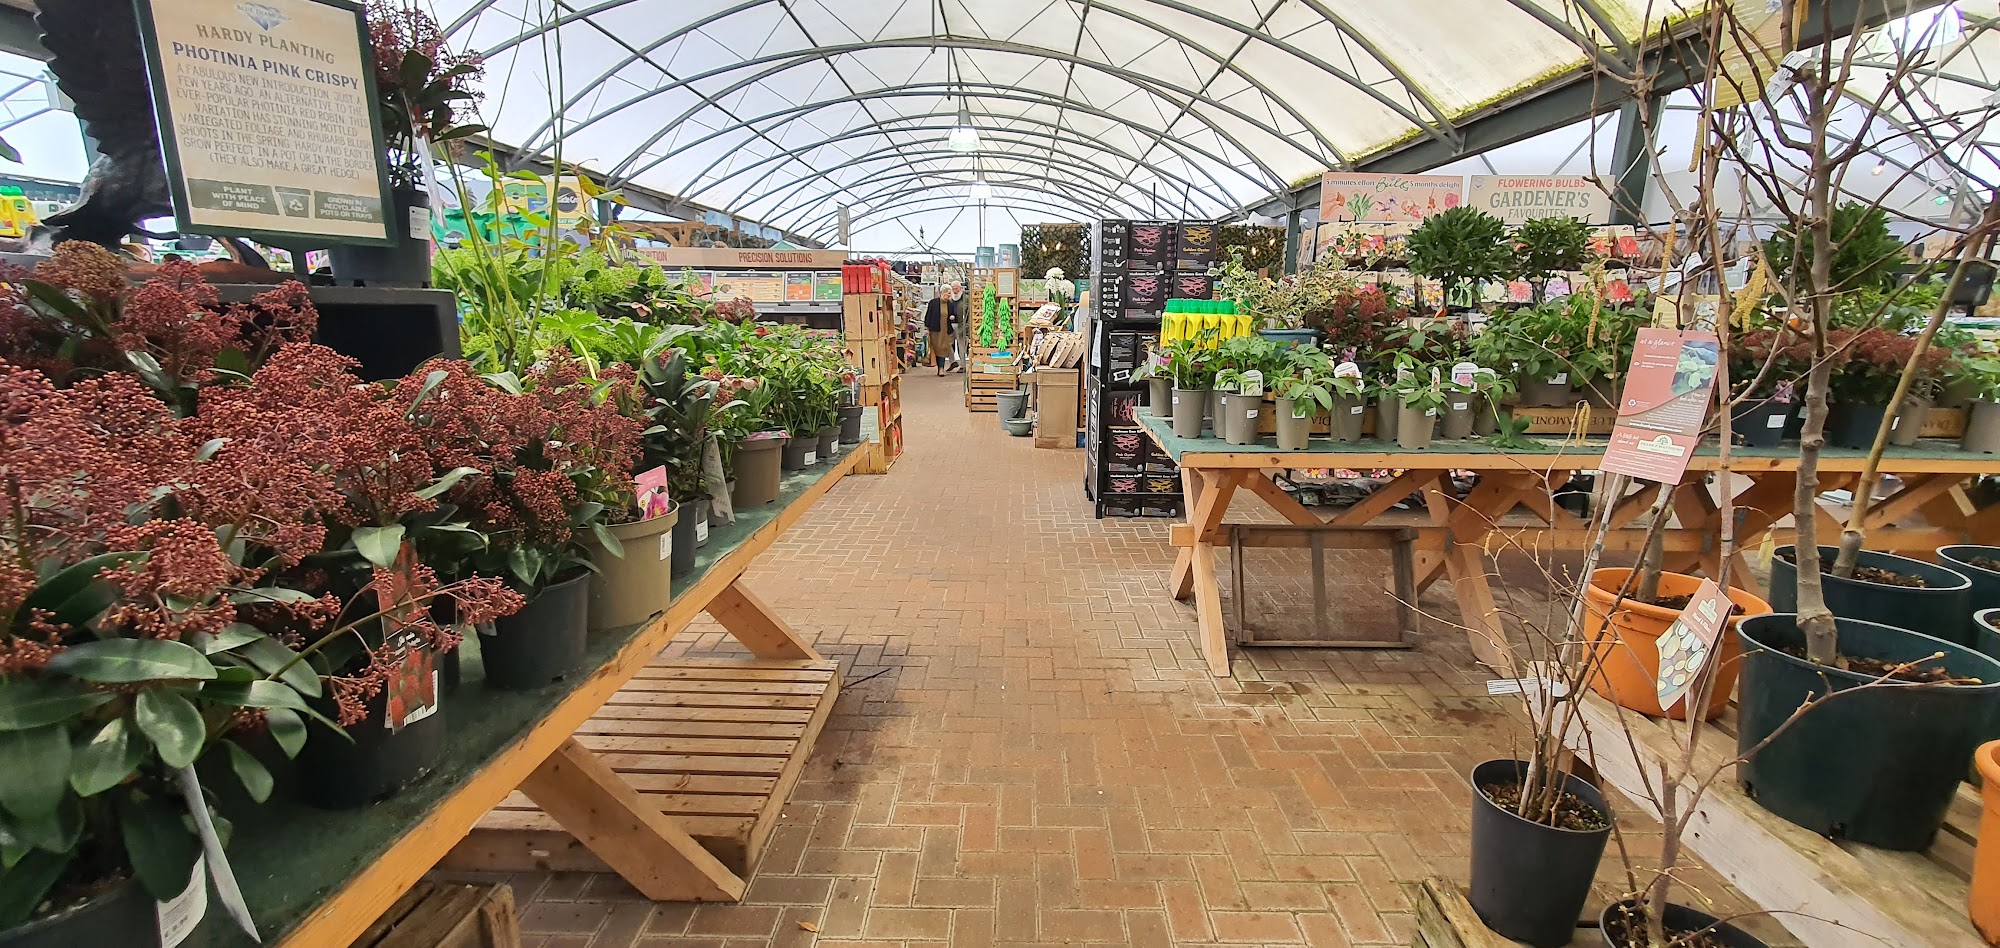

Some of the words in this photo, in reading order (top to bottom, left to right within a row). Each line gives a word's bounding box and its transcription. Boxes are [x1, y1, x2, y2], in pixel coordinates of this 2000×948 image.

[196, 24, 253, 45] HARDY
[258, 33, 335, 65] PLANTING
[172, 41, 258, 71] PHOTINIA
[262, 59, 301, 79] PINK
[305, 68, 359, 90] CRISPY
[177, 63, 185, 74] A
[186, 64, 237, 83] FABULOUS
[239, 74, 259, 87] NEW
[177, 75, 199, 88] FEW
[201, 79, 232, 94] YEARS
[260, 91, 272, 101] AN
[274, 92, 333, 114] ALTERNATIVE
[336, 103, 347, 114] TO
[348, 104, 362, 117] THE
[176, 88, 250, 109] EVER-POPULAR
[251, 99, 298, 117] PHOTINIA
[299, 107, 316, 119] RED
[347, 116, 369, 129] THIS
[194, 101, 251, 121] VARIATION
[252, 112, 272, 124] HAS
[272, 114, 319, 131] STUNNING
[320, 122, 358, 137] MOTTLED
[179, 112, 243, 131] VARIEGATED
[245, 121, 285, 137] FOLIAGE
[287, 128, 305, 140] AND
[307, 130, 346, 147] RHUBARB
[347, 138, 373, 150] BLUSH
[179, 124, 219, 140] SHOOTS
[221, 129, 233, 141] IN
[235, 132, 255, 145] THE
[295, 140, 322, 153] HARDY
[324, 145, 342, 157] AND
[344, 147, 363, 159] EASY
[365, 151, 374, 161] TO
[183, 136, 212, 150] GROW
[213, 140, 254, 156] PERFECT
[258, 148, 270, 158] IN
[272, 149, 279, 158] A
[280, 150, 297, 161] POT
[299, 152, 312, 163] OR
[313, 153, 325, 165] IN
[326, 155, 342, 167] THE
[344, 159, 374, 171] BORDER
[209, 151, 238, 165] (THEY
[240, 156, 265, 168] ALSO
[266, 159, 291, 173] MAKE
[293, 162, 300, 173] A
[301, 163, 328, 177] GREAT
[330, 167, 360, 181] HEDGE)
[222, 185, 253, 195] PLANT
[1330, 179, 1357, 187] minutes
[1357, 179, 1376, 187] effort
[1375, 176, 1411, 194] Bulbs
[1439, 181, 1461, 189] delight
[1498, 179, 1553, 188] FLOWERING
[1555, 179, 1586, 188] BULBS
[211, 191, 237, 202] WITH
[237, 194, 267, 204] PEACE
[222, 200, 233, 208] OF
[235, 201, 260, 210] MIND
[327, 196, 354, 206] GROWN
[354, 198, 363, 207] IN
[1490, 190, 1590, 209] GARDENER'S
[320, 208, 340, 218] POTS
[340, 210, 351, 218] OR
[350, 212, 373, 221] TRAYS
[1508, 208, 1567, 219] FAVOURITES
[738, 251, 774, 263] PRECISION
[775, 252, 813, 264] SOLUTIONS
[1653, 338, 1676, 349] glance
